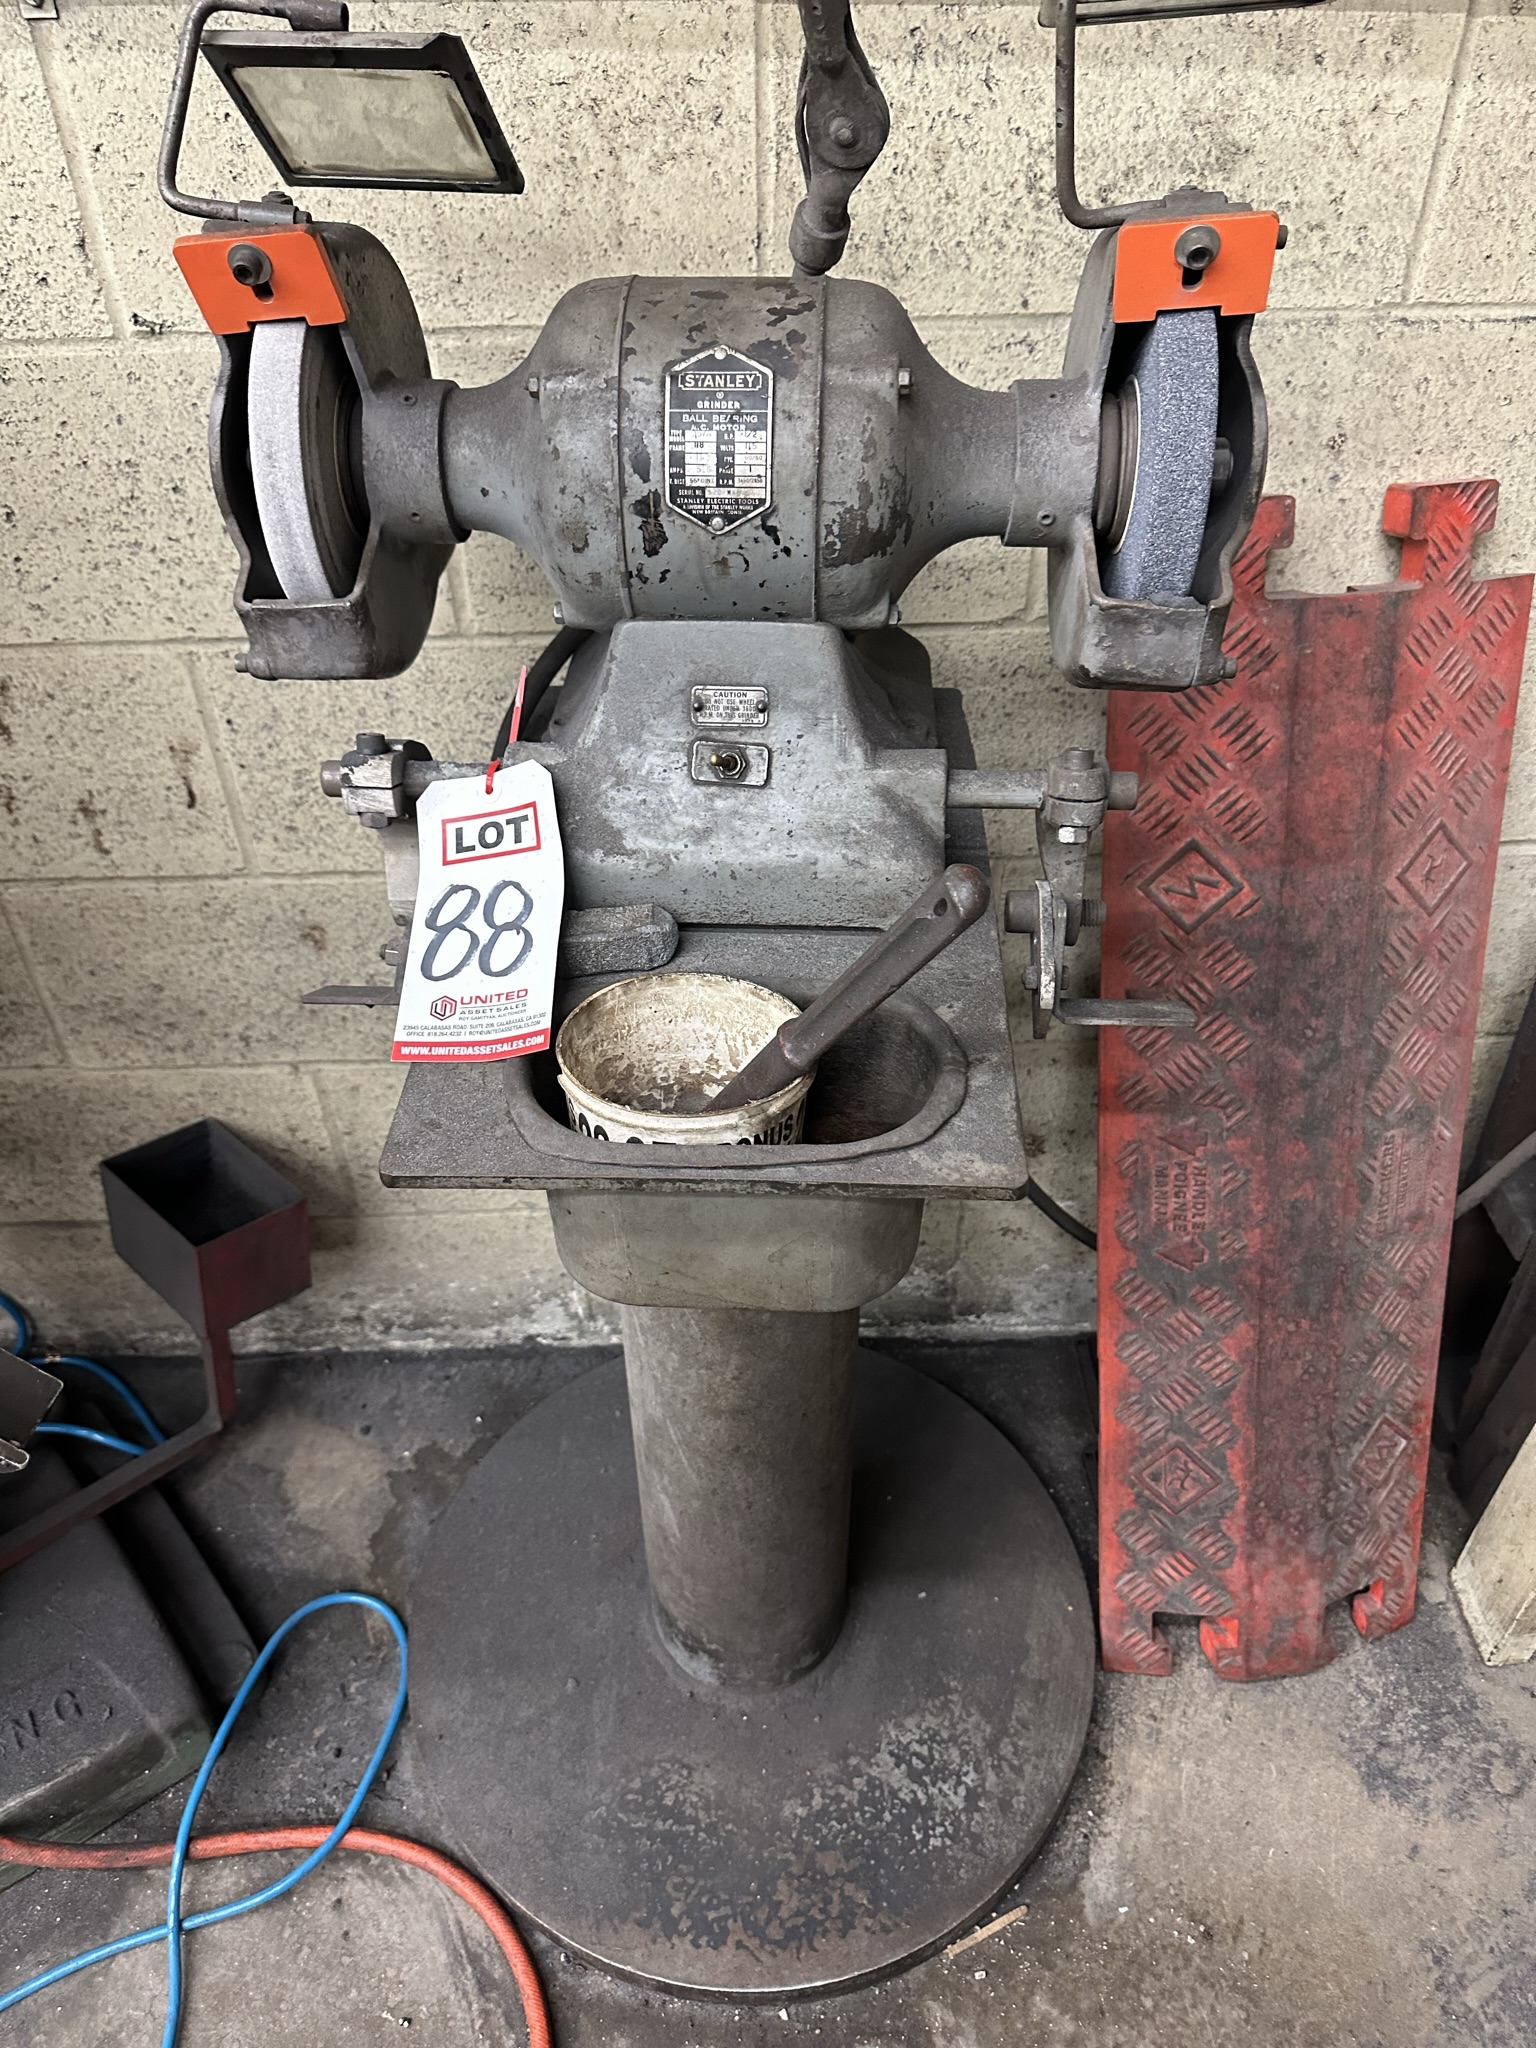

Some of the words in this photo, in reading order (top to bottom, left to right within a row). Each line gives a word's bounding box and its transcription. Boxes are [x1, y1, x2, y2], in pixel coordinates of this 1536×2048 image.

[685, 374, 755, 388] STANLEY
[697, 401, 740, 409] GRINDER
[682, 414, 708, 423] BALL
[455, 814, 529, 854] LOT
[421, 879, 534, 982] 88
[460, 988, 528, 1005] UNITED
[496, 1002, 527, 1012] SALES
[497, 1008, 527, 1018] AUCTIONEER
[400, 1034, 545, 1055] WWW.UNITEDASSETSALES.COM
[717, 1114, 794, 1145] NUS
[1173, 1160, 1188, 1232] POIGNEE
